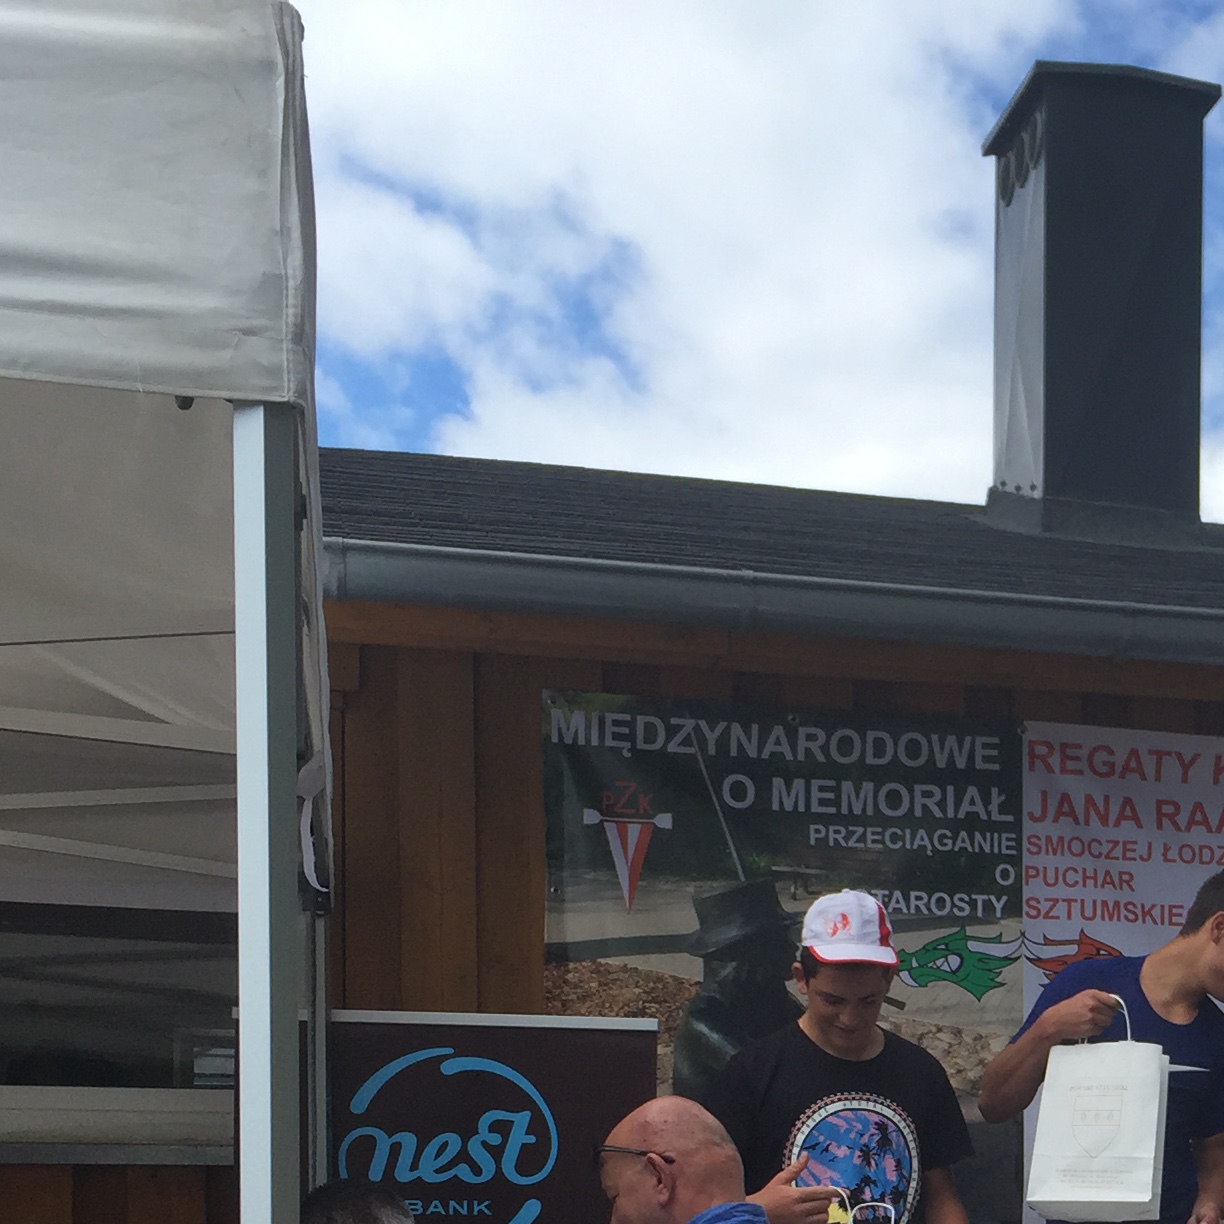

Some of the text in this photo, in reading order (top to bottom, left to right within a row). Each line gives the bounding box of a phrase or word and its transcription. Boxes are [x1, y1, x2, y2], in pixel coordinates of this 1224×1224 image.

[550, 709, 1001, 771] MIĘDZYNARODOWE
[1027, 739, 1201, 785] REGATY
[721, 774, 1015, 822] O MEMORIAŁ
[1027, 790, 1154, 830] JANA
[808, 823, 1017, 857] PRZECIĄGANIE
[1025, 834, 1153, 863] SMOCZEJ
[994, 863, 1016, 887] O
[1024, 865, 1136, 893] PUCHAR
[858, 889, 1009, 919] TAROSTY
[338, 1108, 538, 1186] nest
[404, 1199, 493, 1216] BANK
